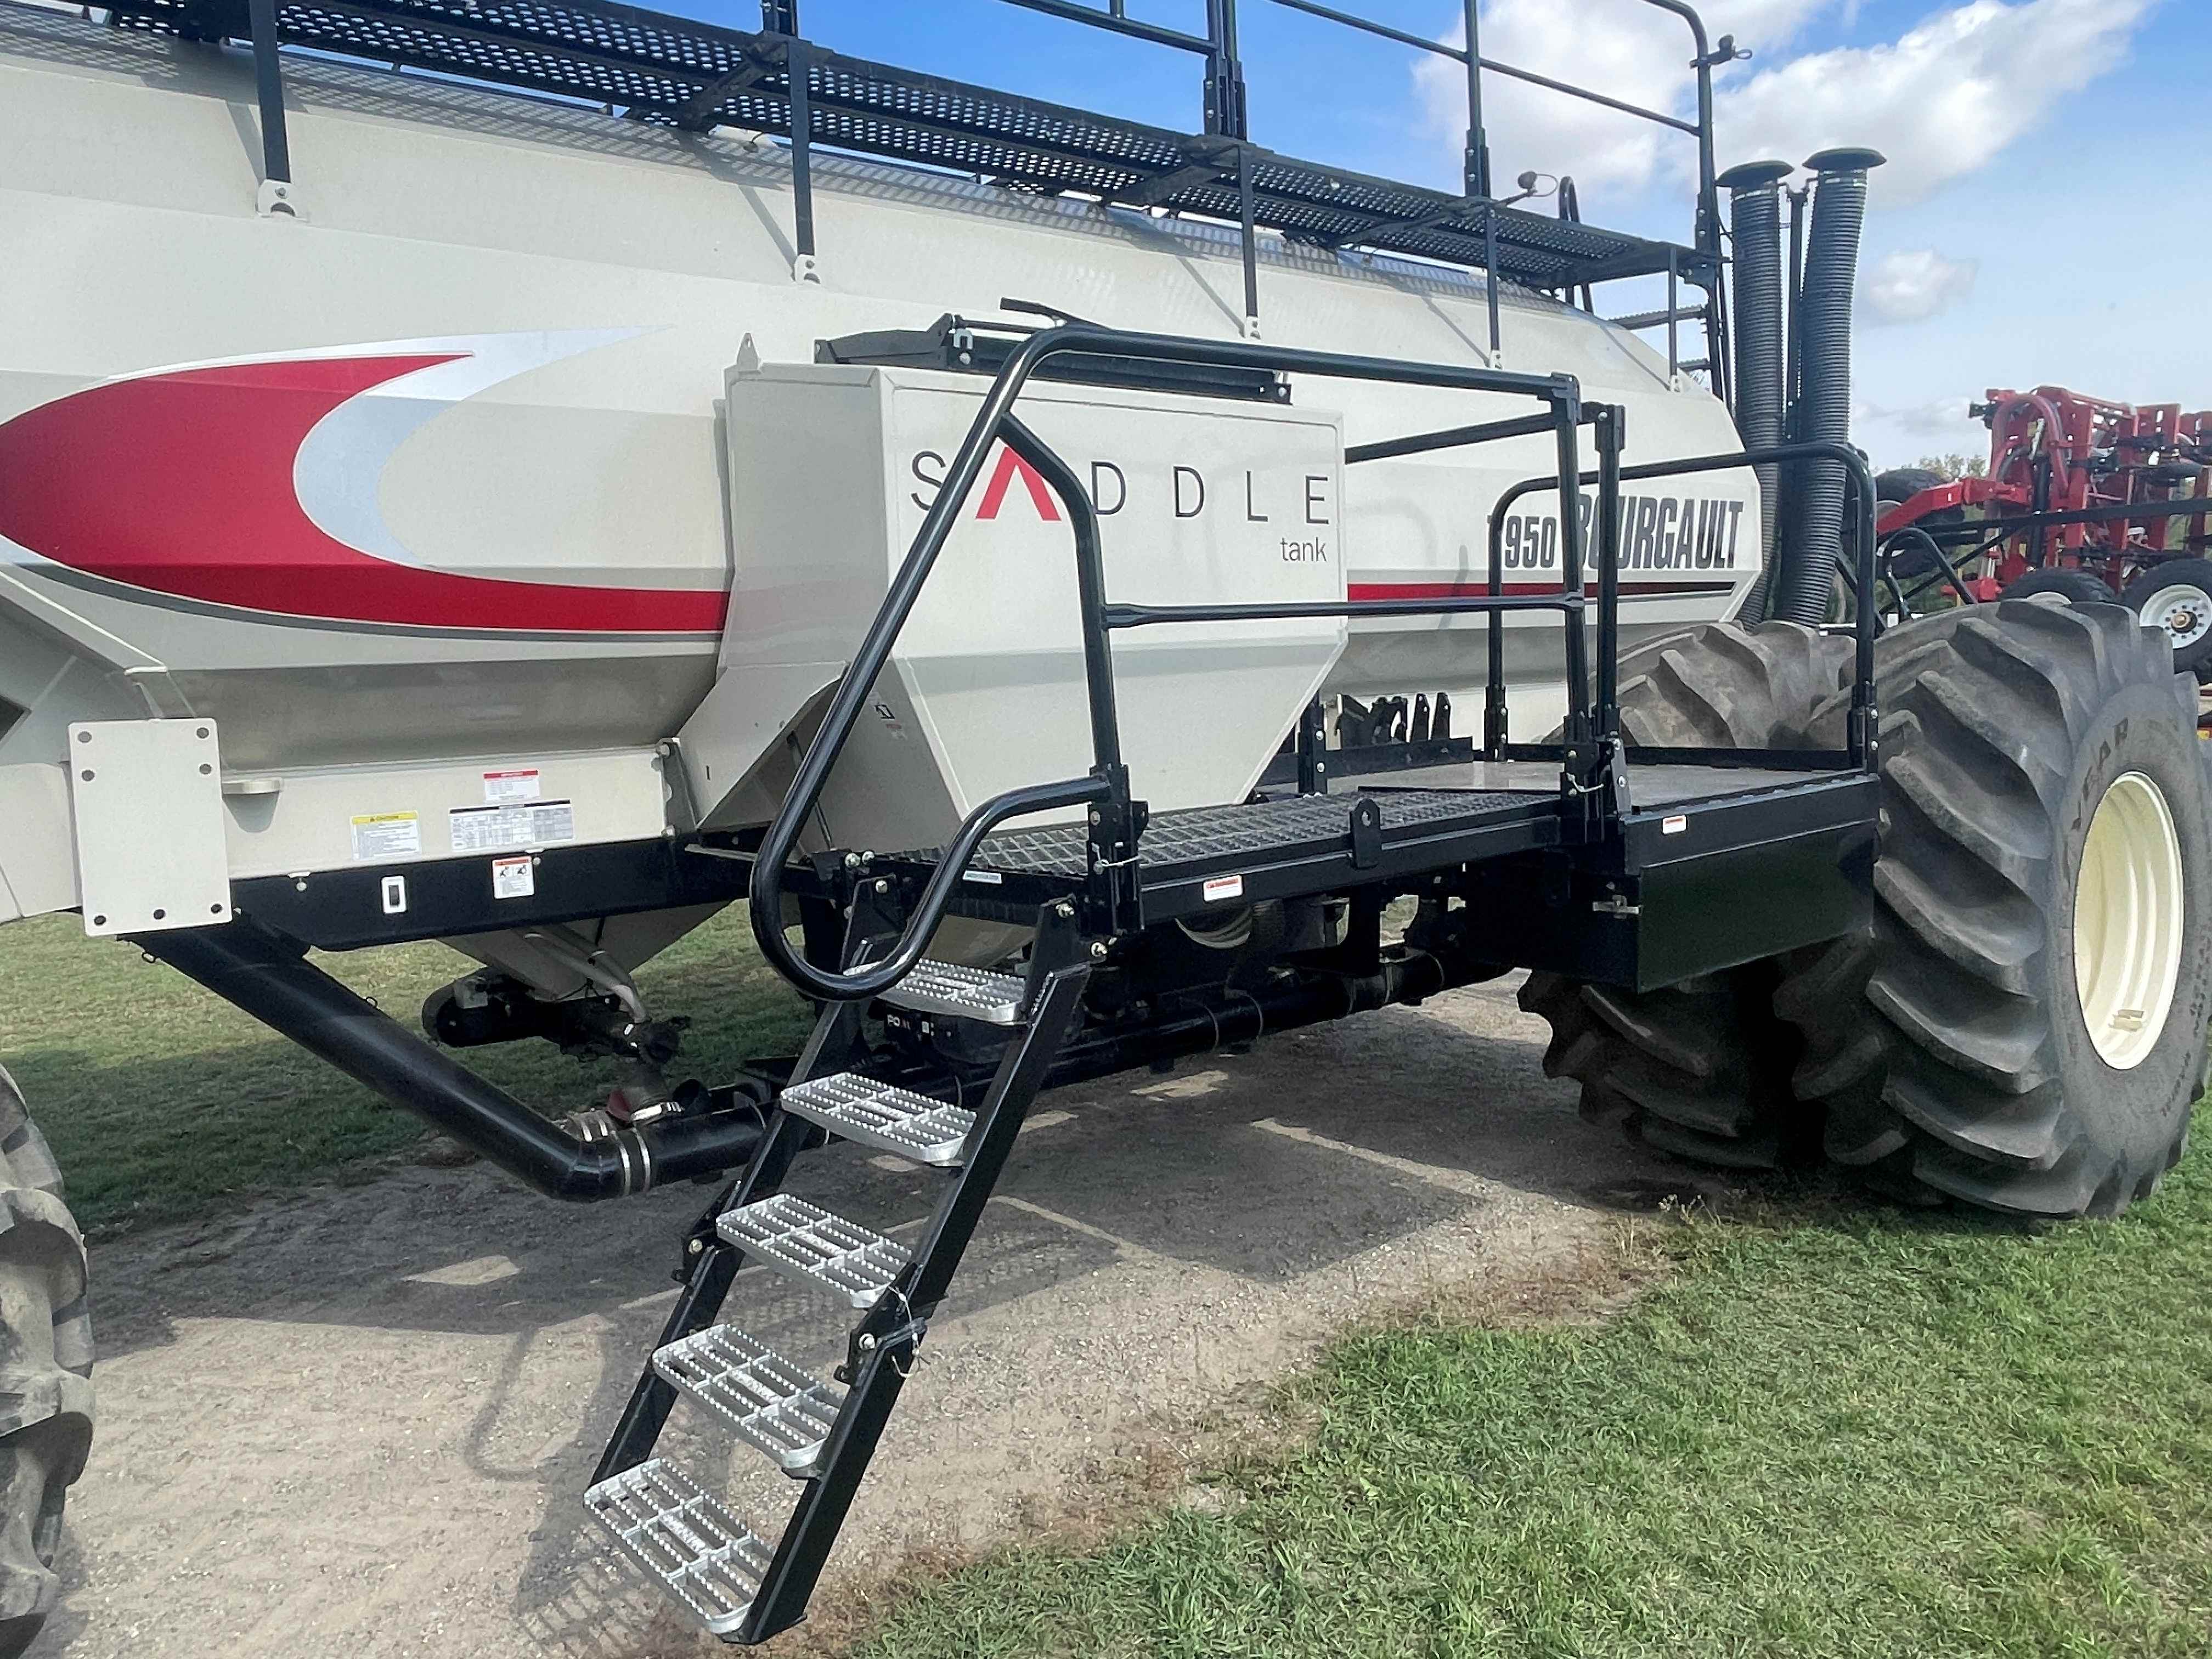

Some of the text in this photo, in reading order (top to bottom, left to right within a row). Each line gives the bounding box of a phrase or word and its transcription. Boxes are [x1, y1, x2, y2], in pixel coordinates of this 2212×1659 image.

[911, 446, 1330, 525] SADDLE
[1280, 536, 1327, 562] tank
[1487, 514, 1557, 568] 950
